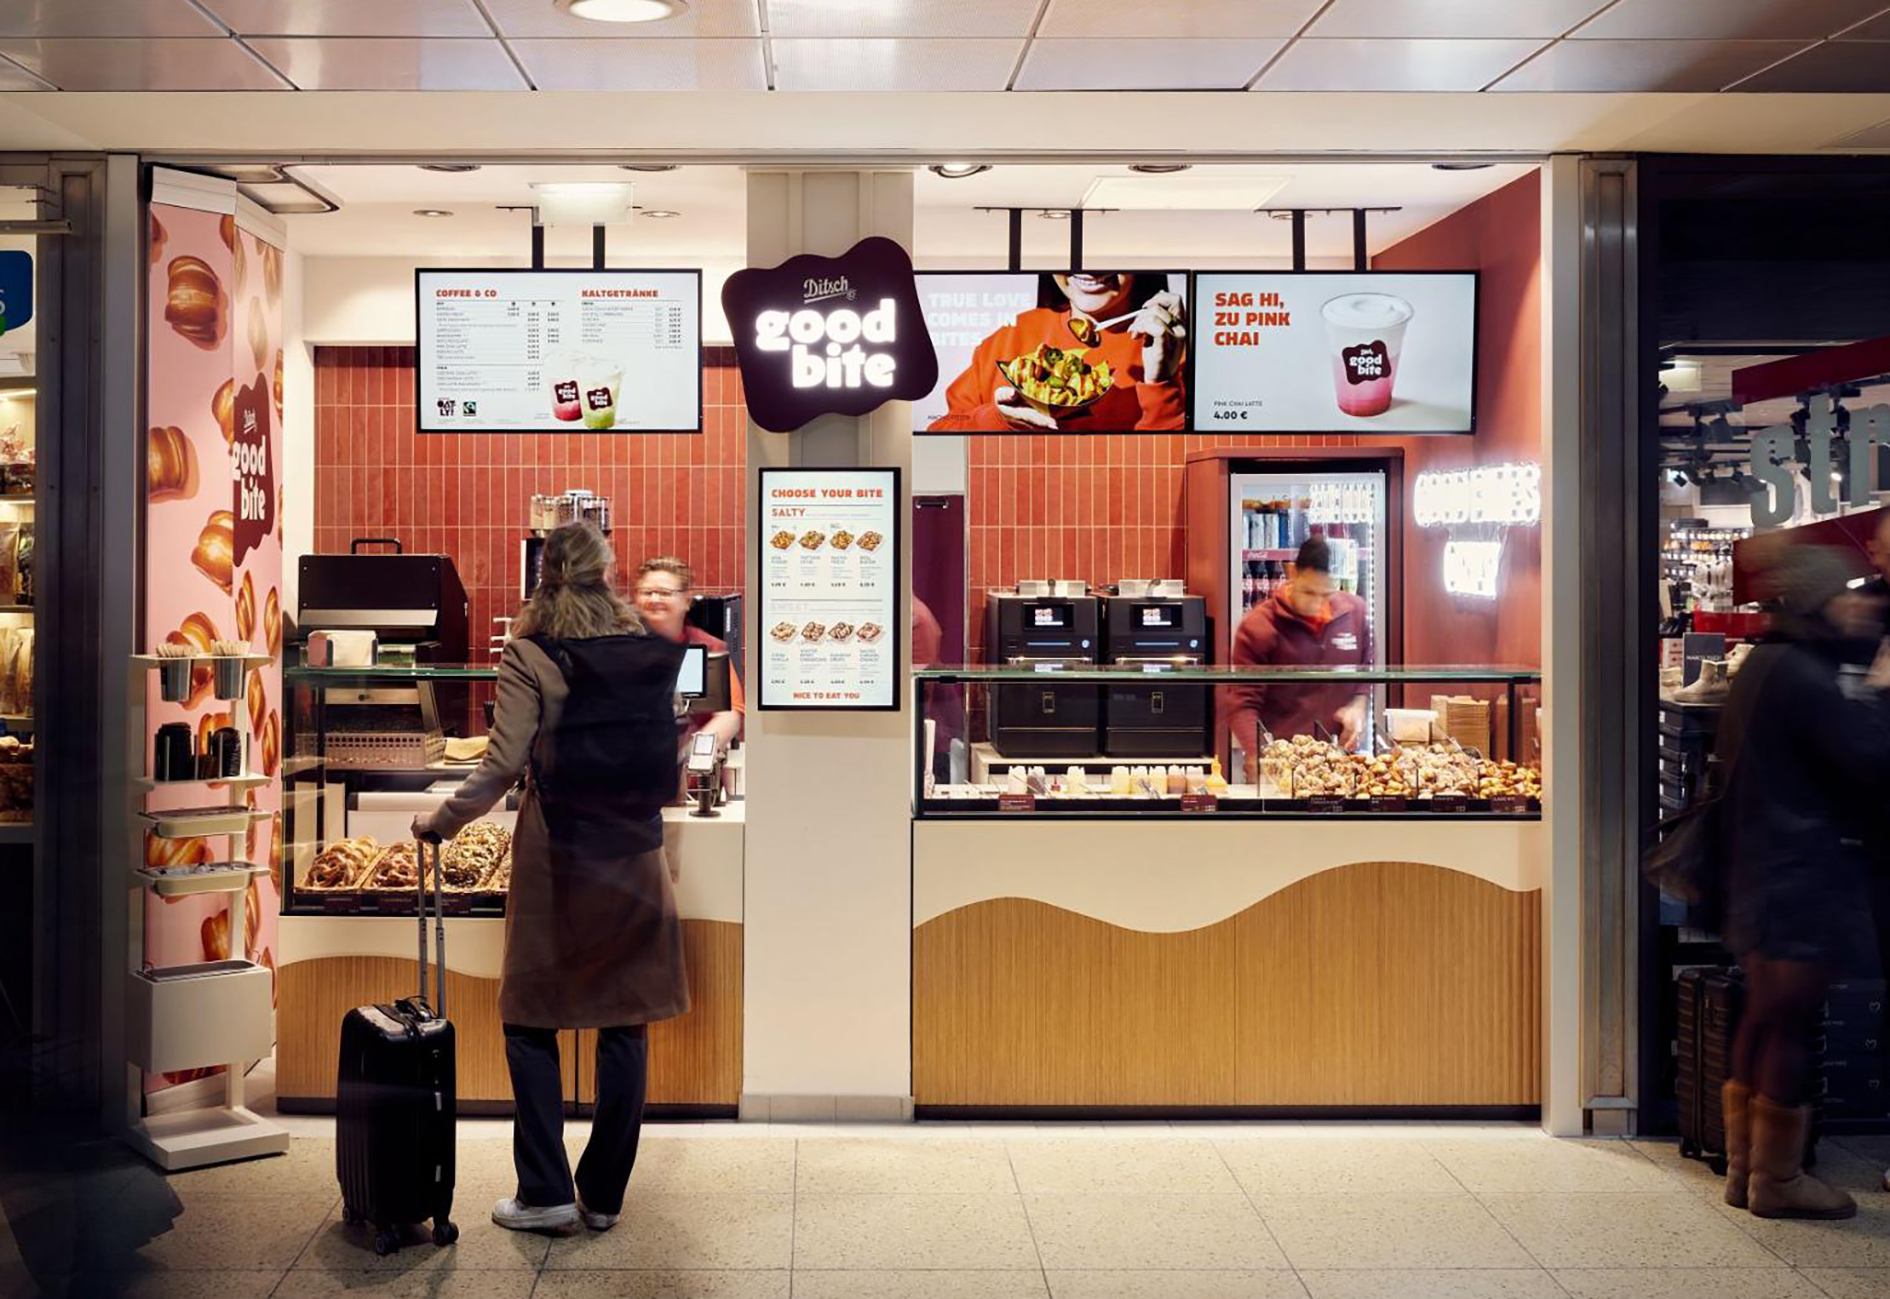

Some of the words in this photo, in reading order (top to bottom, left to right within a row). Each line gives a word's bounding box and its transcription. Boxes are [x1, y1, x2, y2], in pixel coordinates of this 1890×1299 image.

[436, 290, 472, 298] COFFEE
[484, 290, 498, 298] CO
[581, 289, 659, 298] KALTGETRÄNKE
[803, 275, 849, 299] Ditsch
[927, 292, 978, 308] TRUE
[982, 292, 1032, 308] LOVE
[1215, 292, 1254, 307] SAG
[1259, 292, 1285, 309] HI,
[755, 298, 896, 351] good
[927, 312, 991, 328] COMES
[1214, 312, 1240, 327] ZU
[1245, 312, 1290, 327] PINK
[1214, 331, 1260, 346] CHAI
[792, 342, 897, 389] bite
[1349, 354, 1383, 367] good
[1357, 364, 1383, 375] bite
[1213, 410, 1238, 420] 4.00
[1240, 410, 1248, 420] €
[232, 435, 267, 482] good
[240, 476, 266, 521] bite
[771, 489, 816, 498] CHOOSE
[821, 489, 852, 498] YOUR
[856, 489, 883, 498] BITE
[771, 508, 806, 517] SALTY
